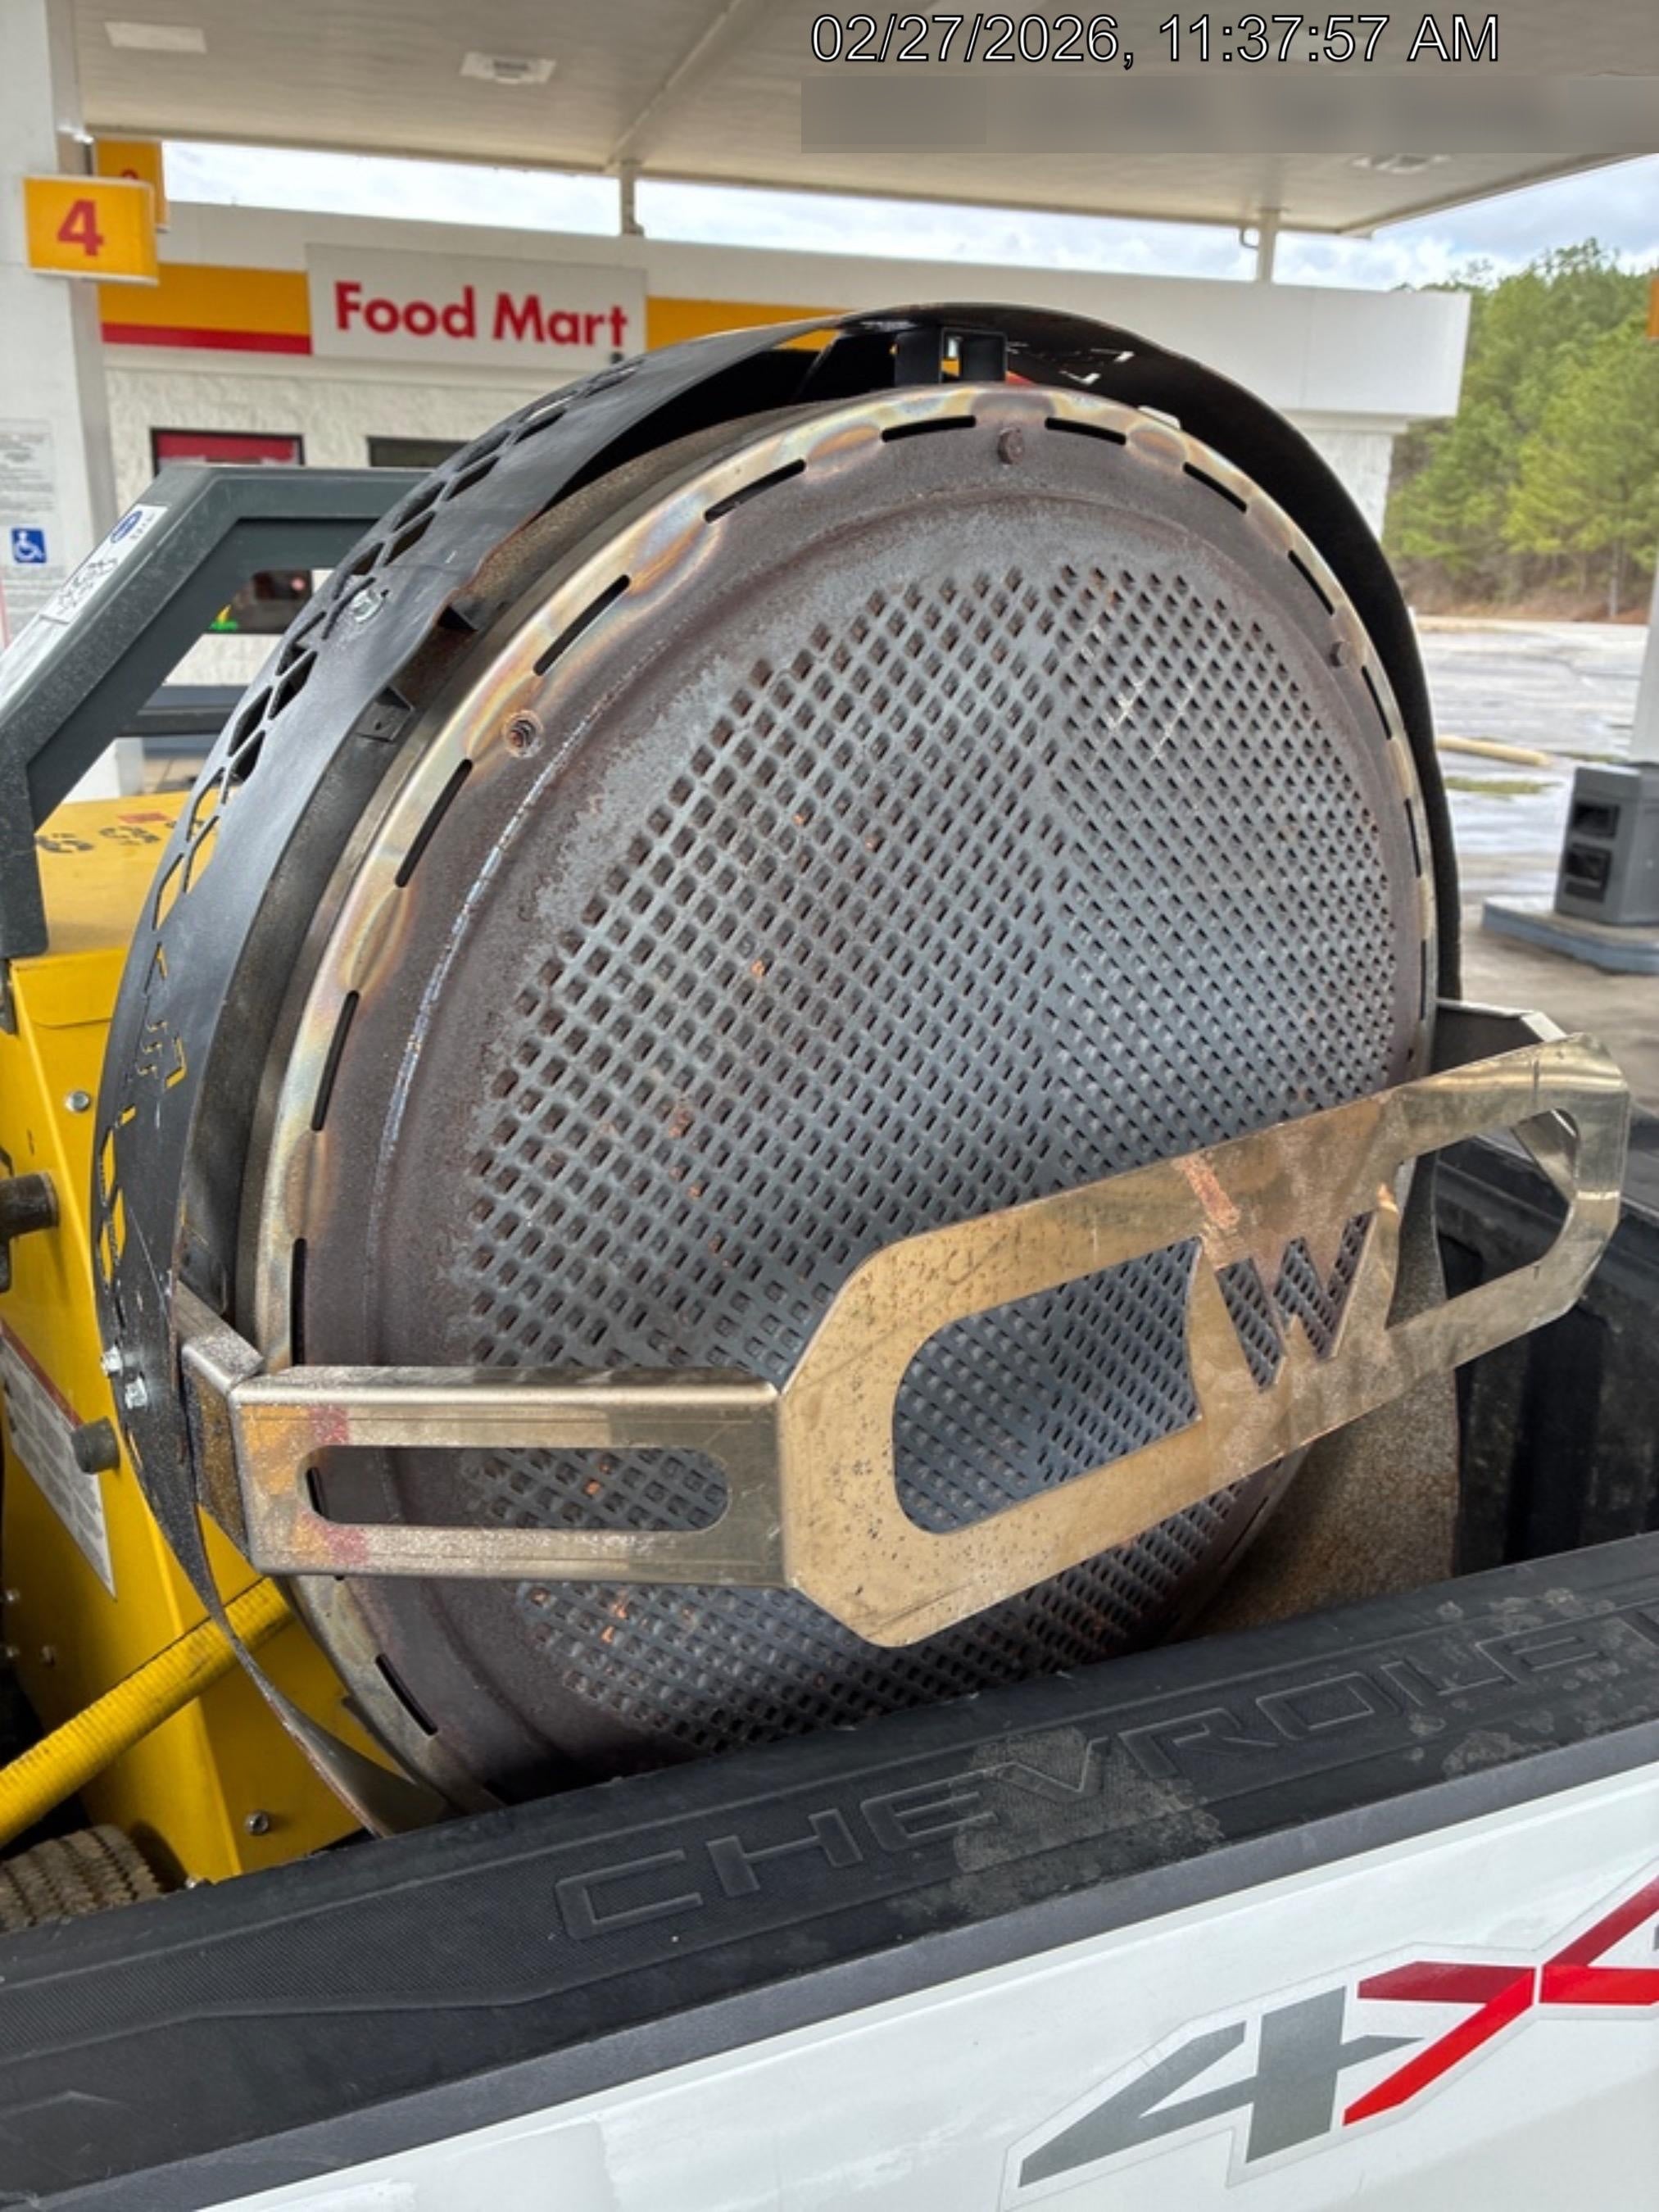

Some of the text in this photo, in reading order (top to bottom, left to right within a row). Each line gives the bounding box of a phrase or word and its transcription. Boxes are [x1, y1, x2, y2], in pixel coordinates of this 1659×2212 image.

[57, 200, 104, 256] 4
[334, 281, 628, 347] Food Mart
[1018, 1874, 1659, 2187] 4X
